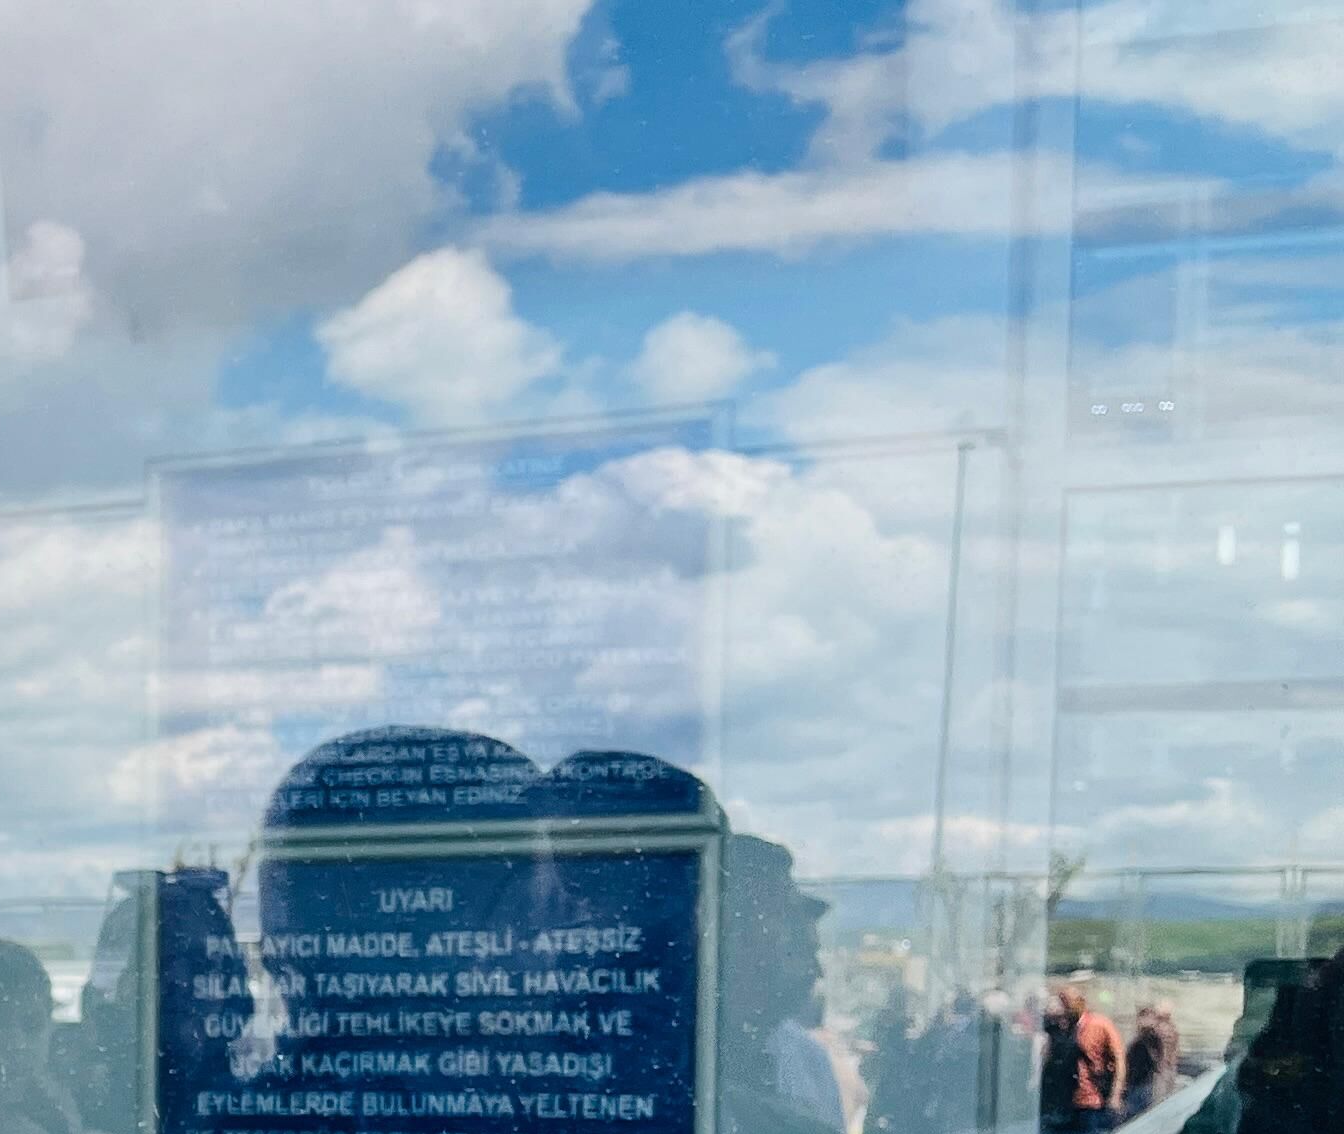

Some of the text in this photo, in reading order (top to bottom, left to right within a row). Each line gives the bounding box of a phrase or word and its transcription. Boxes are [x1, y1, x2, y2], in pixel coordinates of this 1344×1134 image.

[379, 888, 454, 913] UYARI
[205, 933, 320, 959] PAAYICI
[425, 926, 513, 958] ATEŞLİ
[532, 925, 643, 957] ATEŞSİZ
[315, 970, 449, 999] TAŞIYARAK
[455, 965, 517, 997] SİVİL
[524, 967, 661, 994] HAVACILIK
[336, 1009, 472, 1037] TEHLİKEYE
[598, 1009, 634, 1037] VE
[302, 1051, 431, 1079] KAÇIRMAK
[438, 1045, 490, 1077] GİBİ
[496, 1051, 613, 1080] YASADIŞI
[196, 1090, 655, 1120] EYLEMLERDE BULUNMAYA YELTENEN
